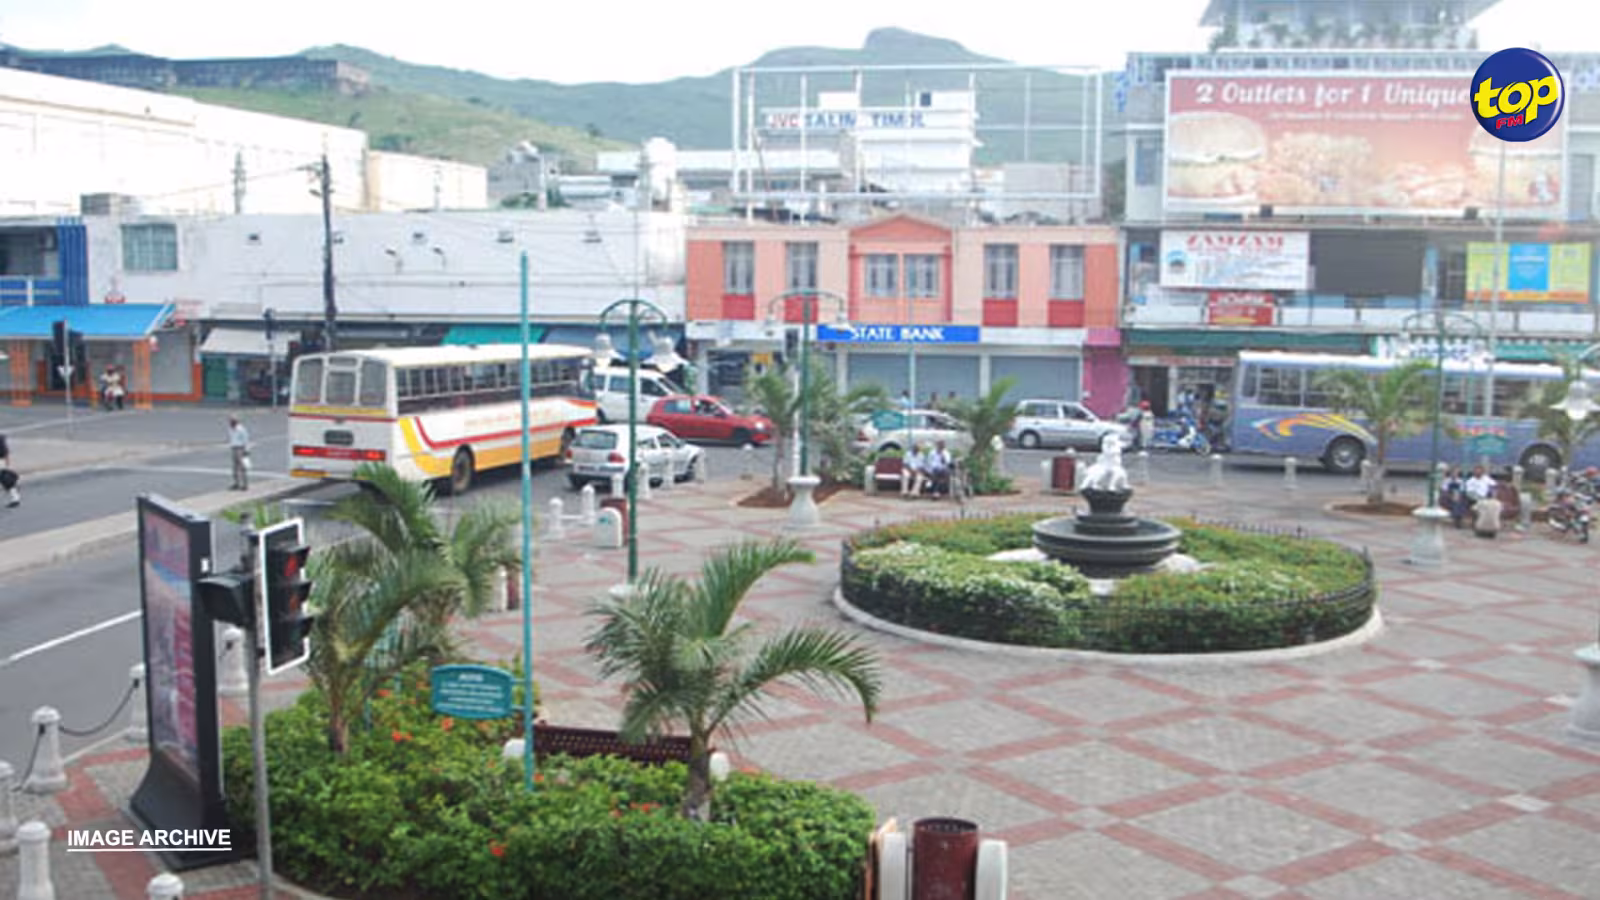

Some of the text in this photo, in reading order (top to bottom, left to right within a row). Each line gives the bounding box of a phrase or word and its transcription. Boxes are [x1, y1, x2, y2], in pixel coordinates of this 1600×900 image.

[1195, 83, 1214, 104] 2
[1222, 82, 1306, 105] Outlets
[1314, 83, 1353, 108] for
[770, 112, 799, 128] JVC
[851, 325, 945, 341] STATE BANK
